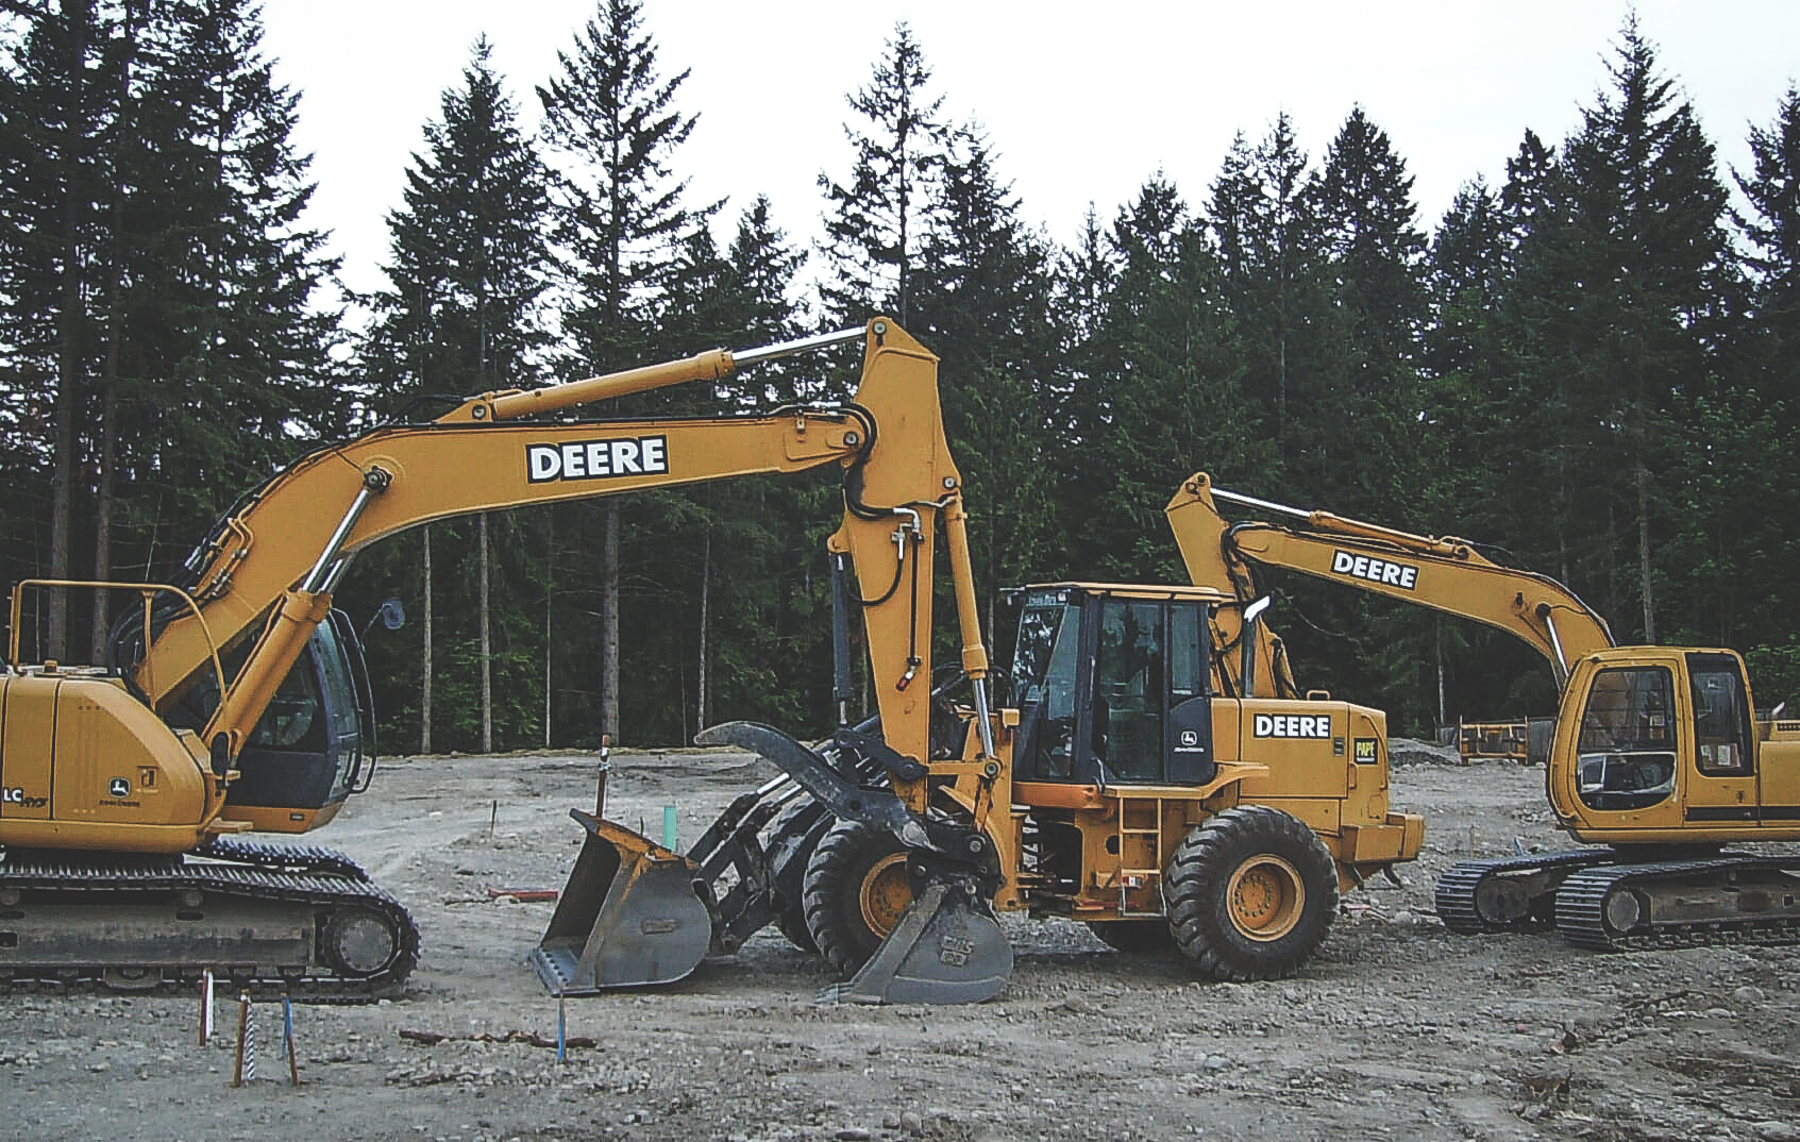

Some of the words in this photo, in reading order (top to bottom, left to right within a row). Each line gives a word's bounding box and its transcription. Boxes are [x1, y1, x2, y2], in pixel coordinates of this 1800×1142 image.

[529, 438, 666, 480] DEERE
[1333, 551, 1416, 588] DEERE
[1256, 715, 1329, 737] DEERE
[3, 789, 22, 802] LC
